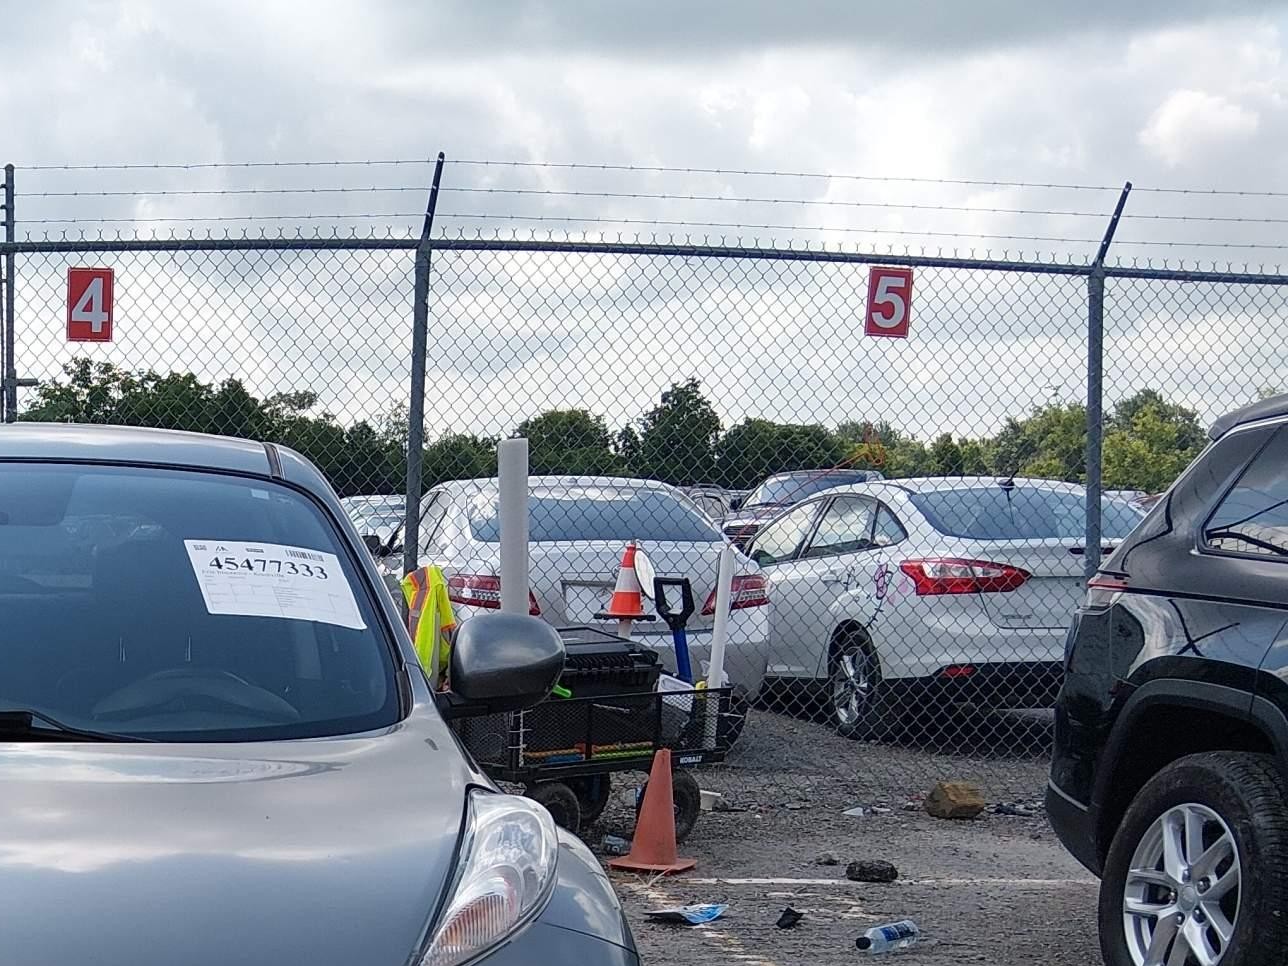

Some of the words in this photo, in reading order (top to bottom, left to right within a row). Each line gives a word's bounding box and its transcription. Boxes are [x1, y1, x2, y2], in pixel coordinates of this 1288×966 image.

[71, 277, 109, 333] 4
[871, 276, 906, 329] 5
[209, 556, 329, 581] 45477333
[679, 755, 703, 764] KOBALT
